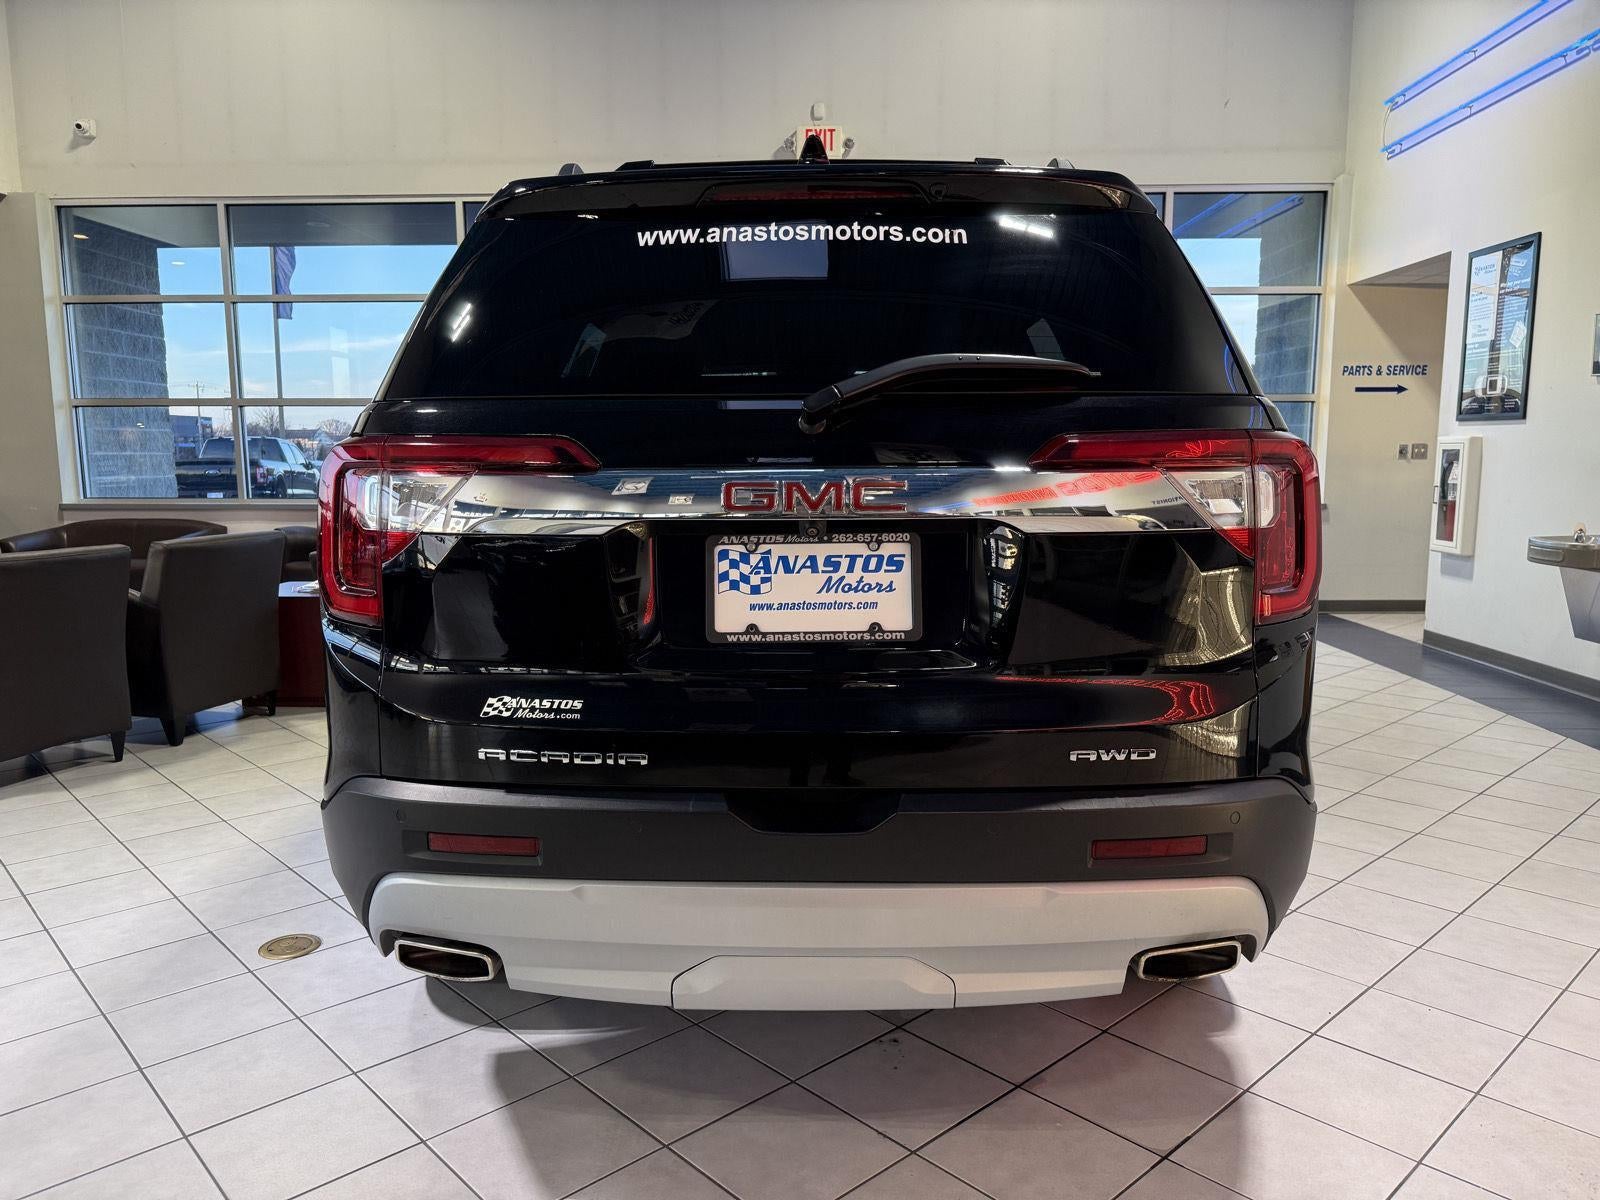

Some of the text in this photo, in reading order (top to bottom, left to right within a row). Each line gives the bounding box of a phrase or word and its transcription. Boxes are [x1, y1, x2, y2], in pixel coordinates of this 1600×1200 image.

[637, 221, 968, 247] www.anastosmotors.com
[1342, 364, 1428, 376] PARTS & SERVICE
[721, 480, 908, 514] GMC
[718, 532, 911, 544] ANASTOS Motors 262-657-6020
[748, 553, 906, 575] ANASTOS
[816, 575, 897, 595] Motors
[749, 600, 878, 612] www.anastosmotors.com
[726, 631, 905, 643] www.anastosmotors.com
[504, 697, 584, 710] ANASTOS
[477, 748, 649, 766] ACADIA
[1069, 748, 1157, 762] AWD
